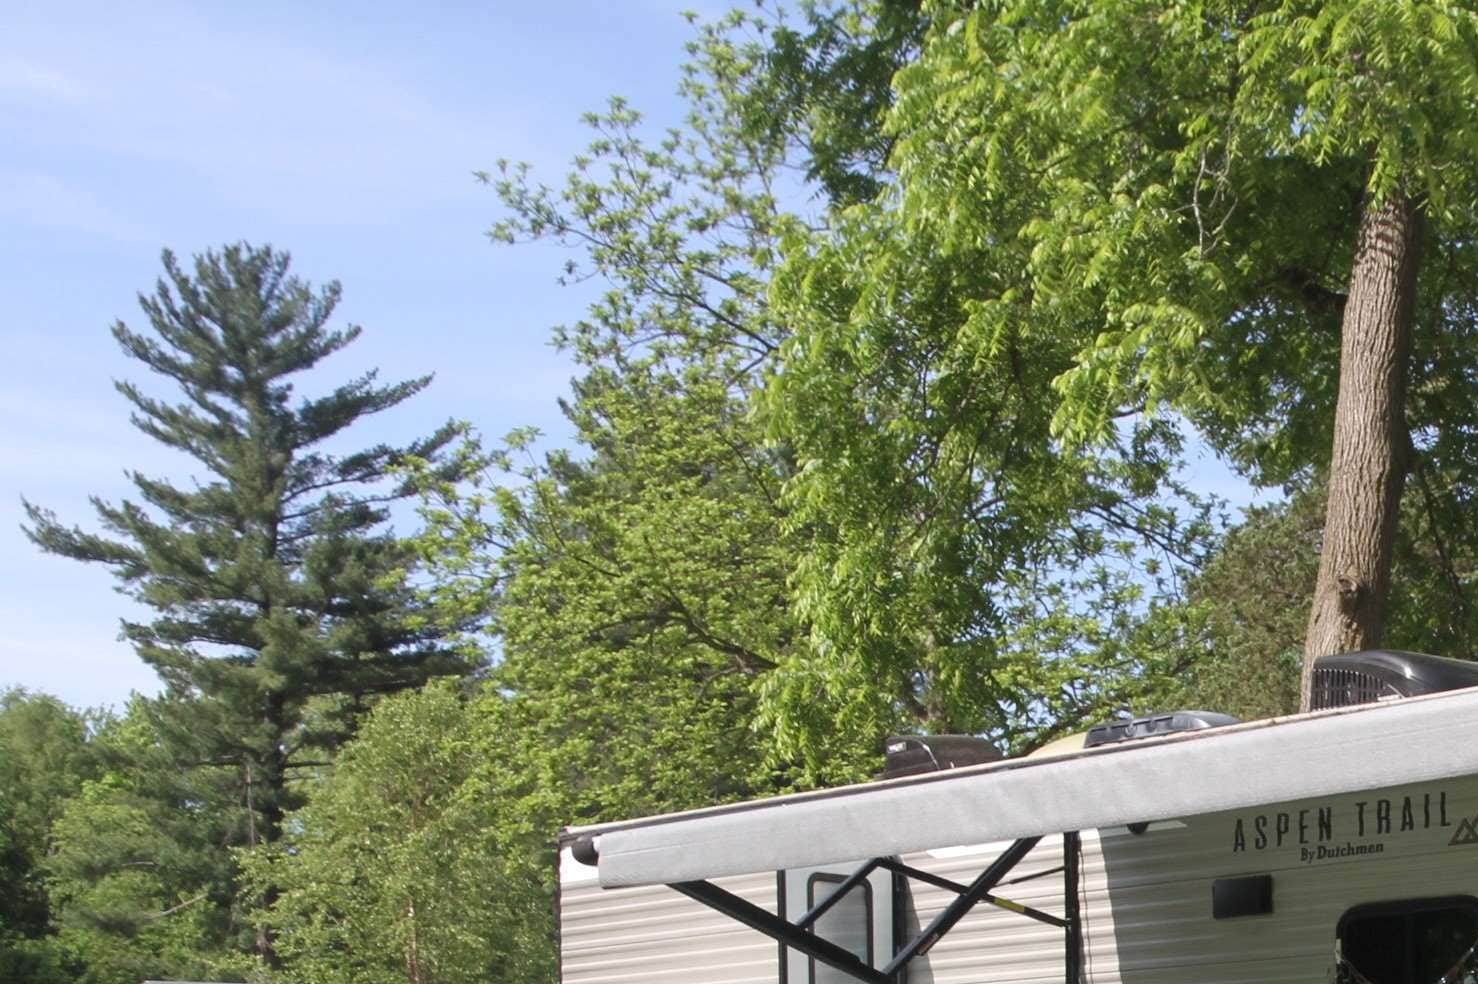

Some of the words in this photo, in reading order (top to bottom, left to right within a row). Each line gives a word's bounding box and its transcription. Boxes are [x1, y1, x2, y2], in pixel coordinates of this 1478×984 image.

[1233, 806, 1332, 852] ASPEN
[1356, 791, 1451, 837] TRAIL
[1300, 847, 1315, 863] By
[1316, 841, 1384, 860] Dutchmen
